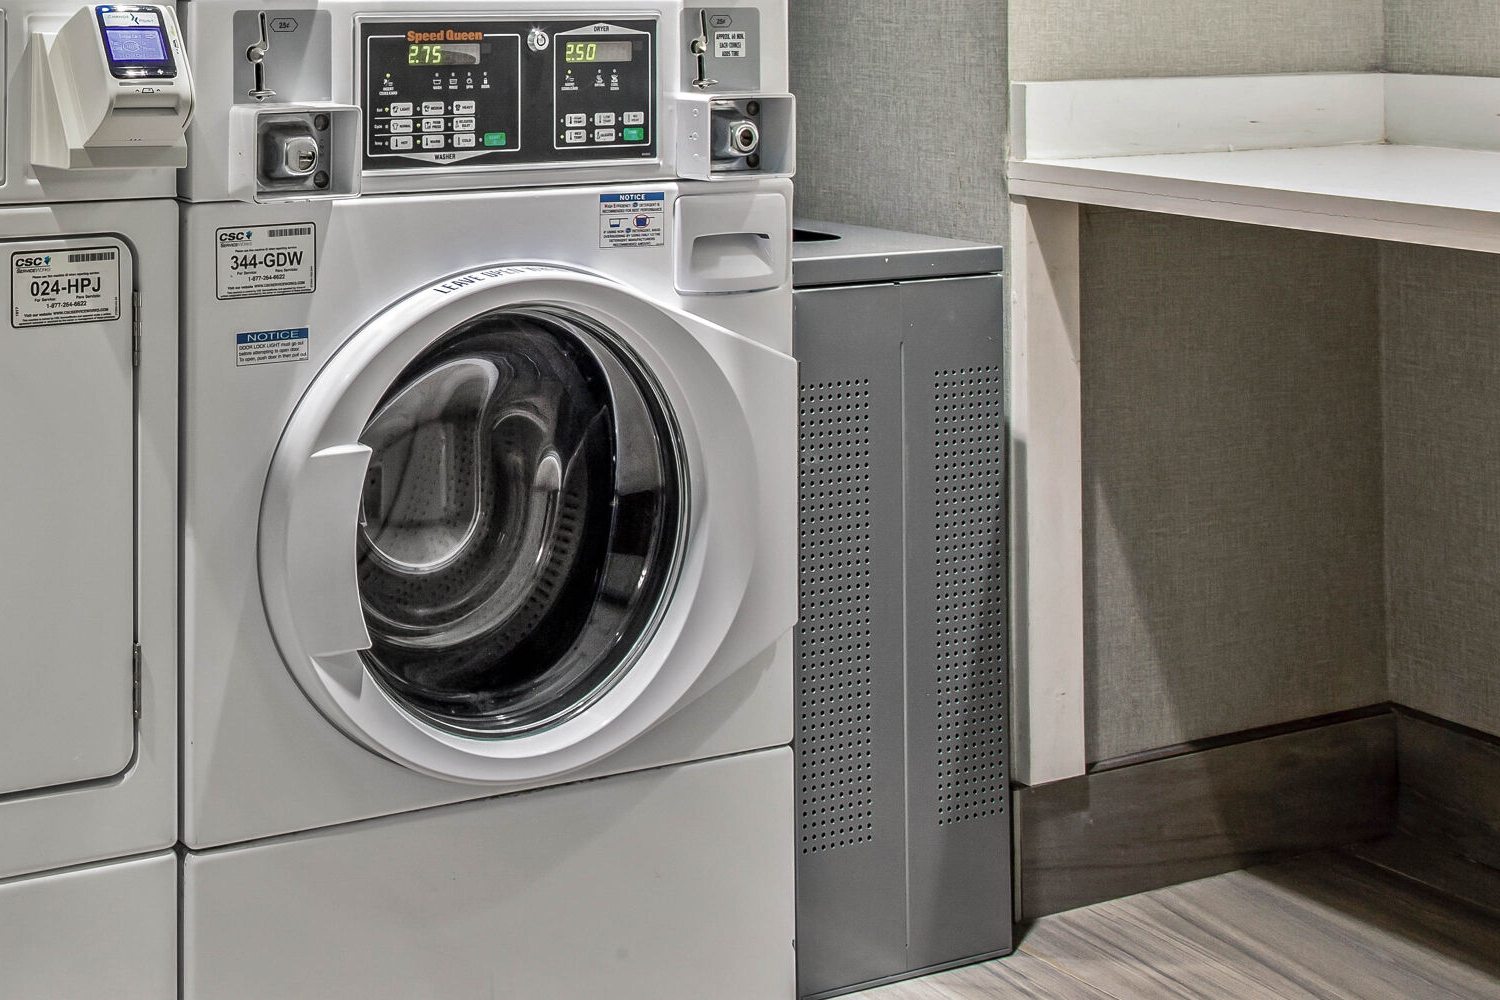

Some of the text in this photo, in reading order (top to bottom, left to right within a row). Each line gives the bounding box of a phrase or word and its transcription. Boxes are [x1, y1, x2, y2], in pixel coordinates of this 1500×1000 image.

[407, 30, 483, 43] Speed Queen
[409, 46, 441, 64] 2.75
[220, 232, 244, 241] CSC
[16, 257, 42, 267] CSC
[231, 251, 303, 270] 344-GDW
[30, 277, 101, 296] 024-HPJ
[434, 276, 485, 294] LEAVE
[248, 330, 299, 342] NOTICE
